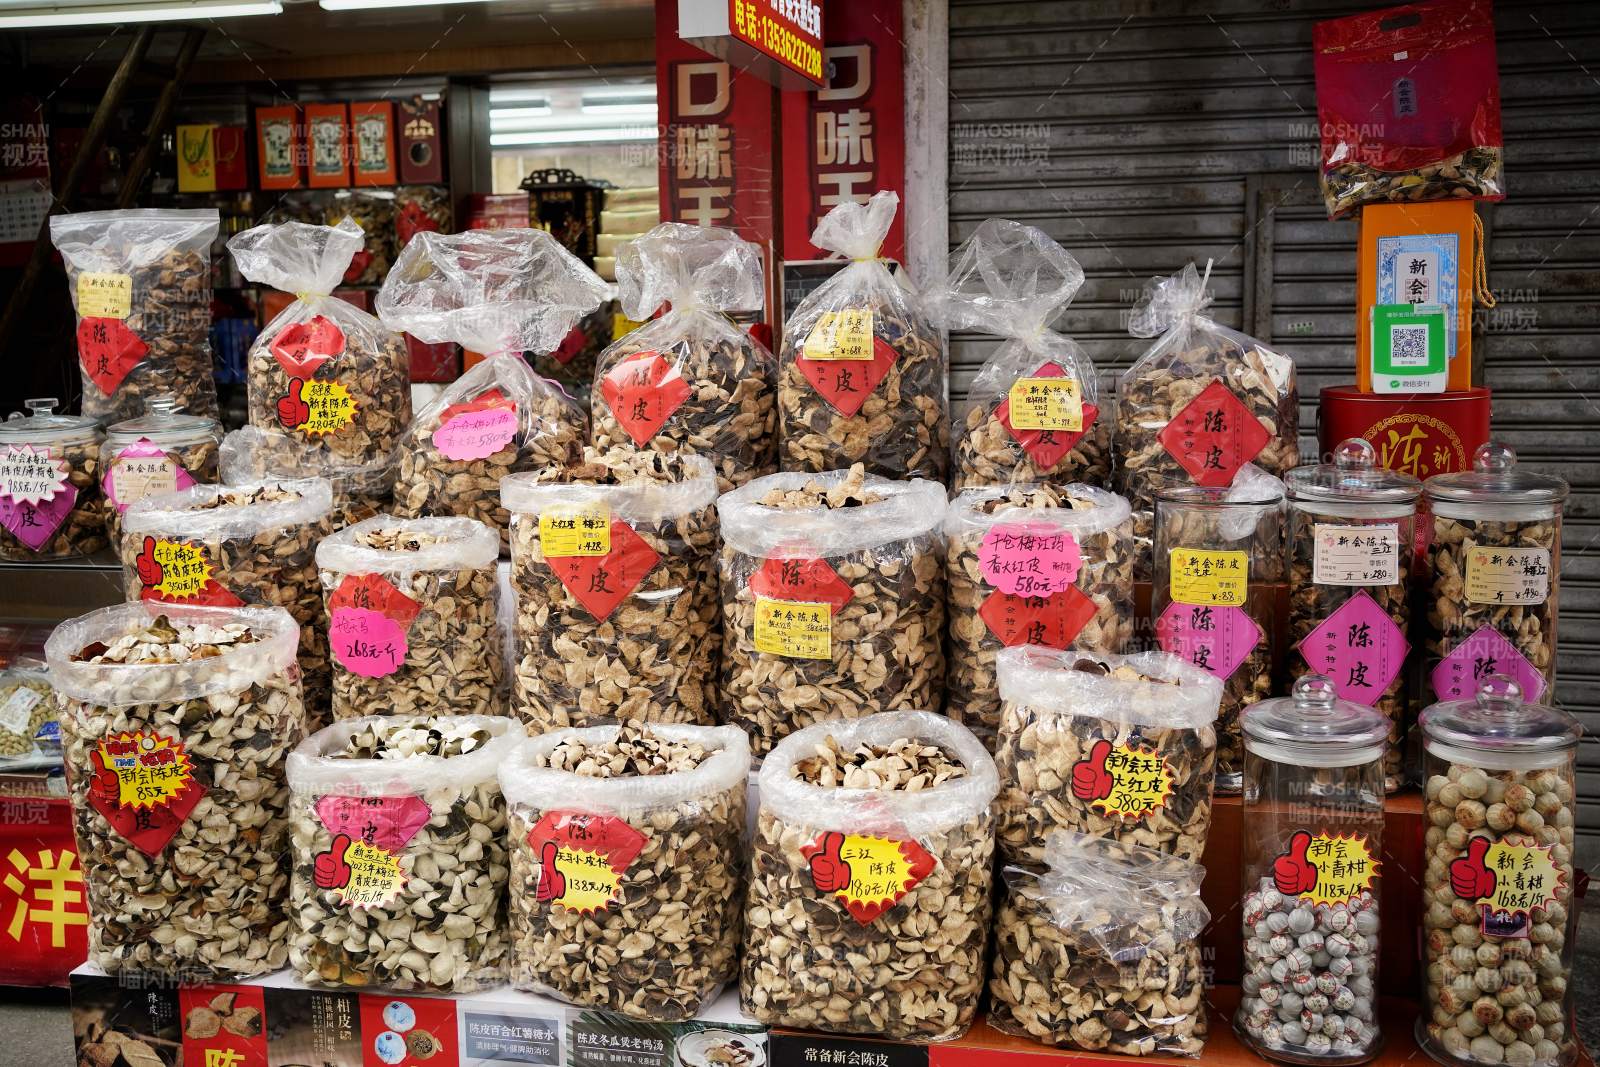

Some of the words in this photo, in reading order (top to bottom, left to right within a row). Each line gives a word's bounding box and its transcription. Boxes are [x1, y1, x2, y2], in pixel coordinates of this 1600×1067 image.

[1408, 258, 1428, 304] 新会
[93, 320, 114, 376] 陈皮
[835, 368, 859, 393] 皮
[1204, 408, 1228, 471] 陈皮
[126, 463, 168, 473] 新会陈皮
[21, 506, 43, 527] 皮
[1337, 536, 1389, 547] 新会陈皮
[1188, 557, 1240, 569] 新会陈皮
[1490, 555, 1543, 566] 新会陈皮
[588, 567, 615, 594] 皮
[782, 557, 805, 586] 陈
[353, 584, 375, 609] 陈
[772, 609, 821, 623] 新会陈皮
[1191, 605, 1216, 671] 陈皮
[1326, 632, 1337, 675] 新会特产
[1346, 621, 1373, 688] 陈皮
[1107, 749, 1164, 776] 新会天马
[119, 764, 185, 785] 新会陈皮
[1113, 774, 1164, 794] 大红皮
[136, 786, 168, 801] 85元
[1110, 791, 1156, 812] 380元
[843, 848, 874, 859] 三江
[1311, 839, 1348, 858] 新会
[869, 861, 896, 875] 陈皮
[1317, 859, 1368, 878] 小青柑
[1497, 851, 1535, 870] 新会
[1498, 872, 1544, 890] 小青柑
[3, 848, 88, 948] 洋
[148, 992, 159, 1015] 陳皮
[337, 998, 352, 1028] 柑皮
[577, 1032, 664, 1051] 陈皮冬瓜煲老鸭汤
[804, 1047, 889, 1067] 常备新会陈皮
